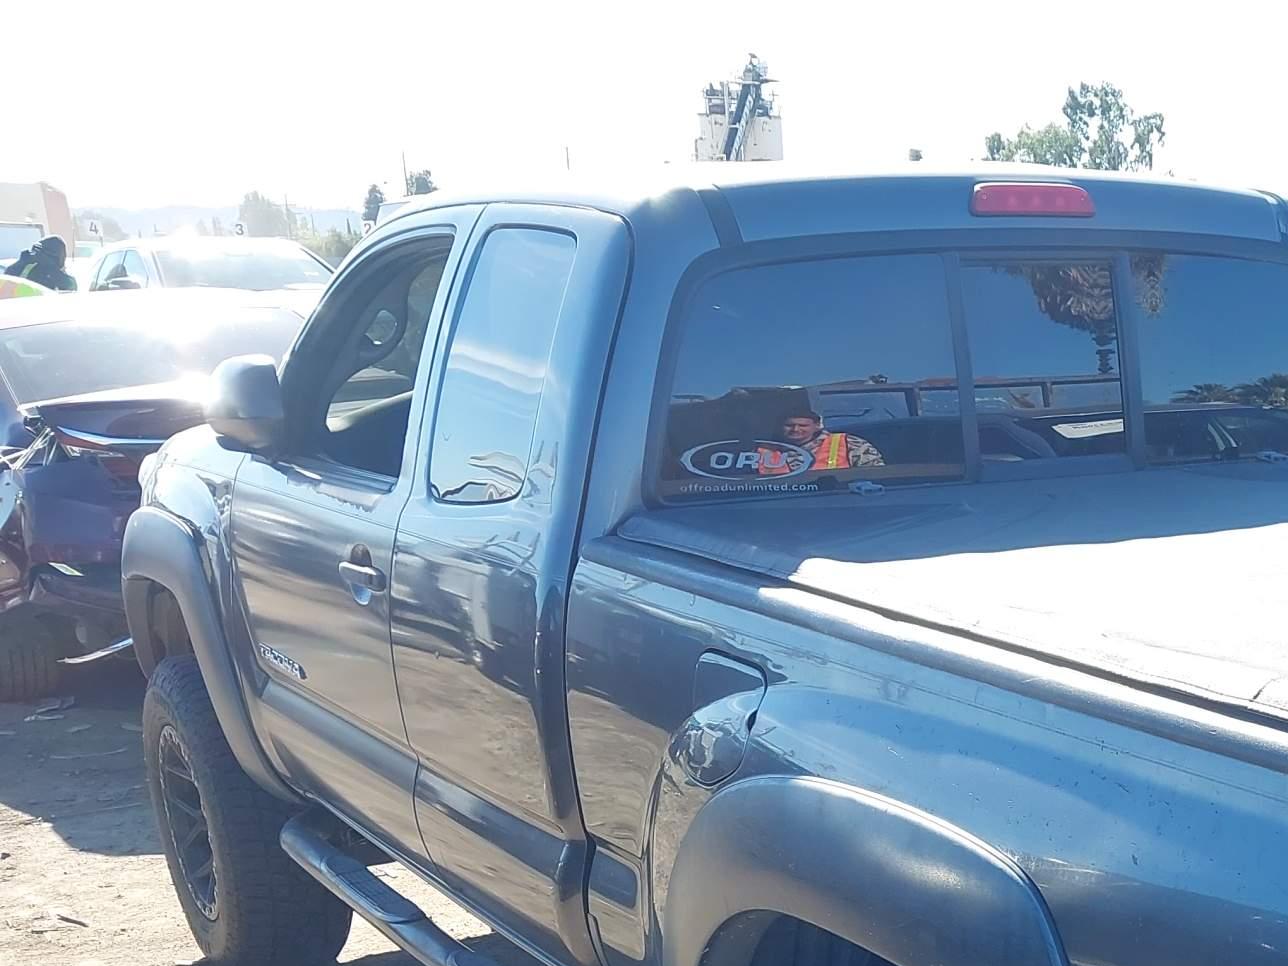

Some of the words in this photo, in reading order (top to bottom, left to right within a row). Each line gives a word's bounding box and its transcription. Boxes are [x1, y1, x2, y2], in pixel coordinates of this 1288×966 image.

[89, 221, 99, 235] 4
[235, 223, 244, 236] 3
[709, 451, 788, 470] ORU
[680, 482, 818, 494] offroadunlimited.com
